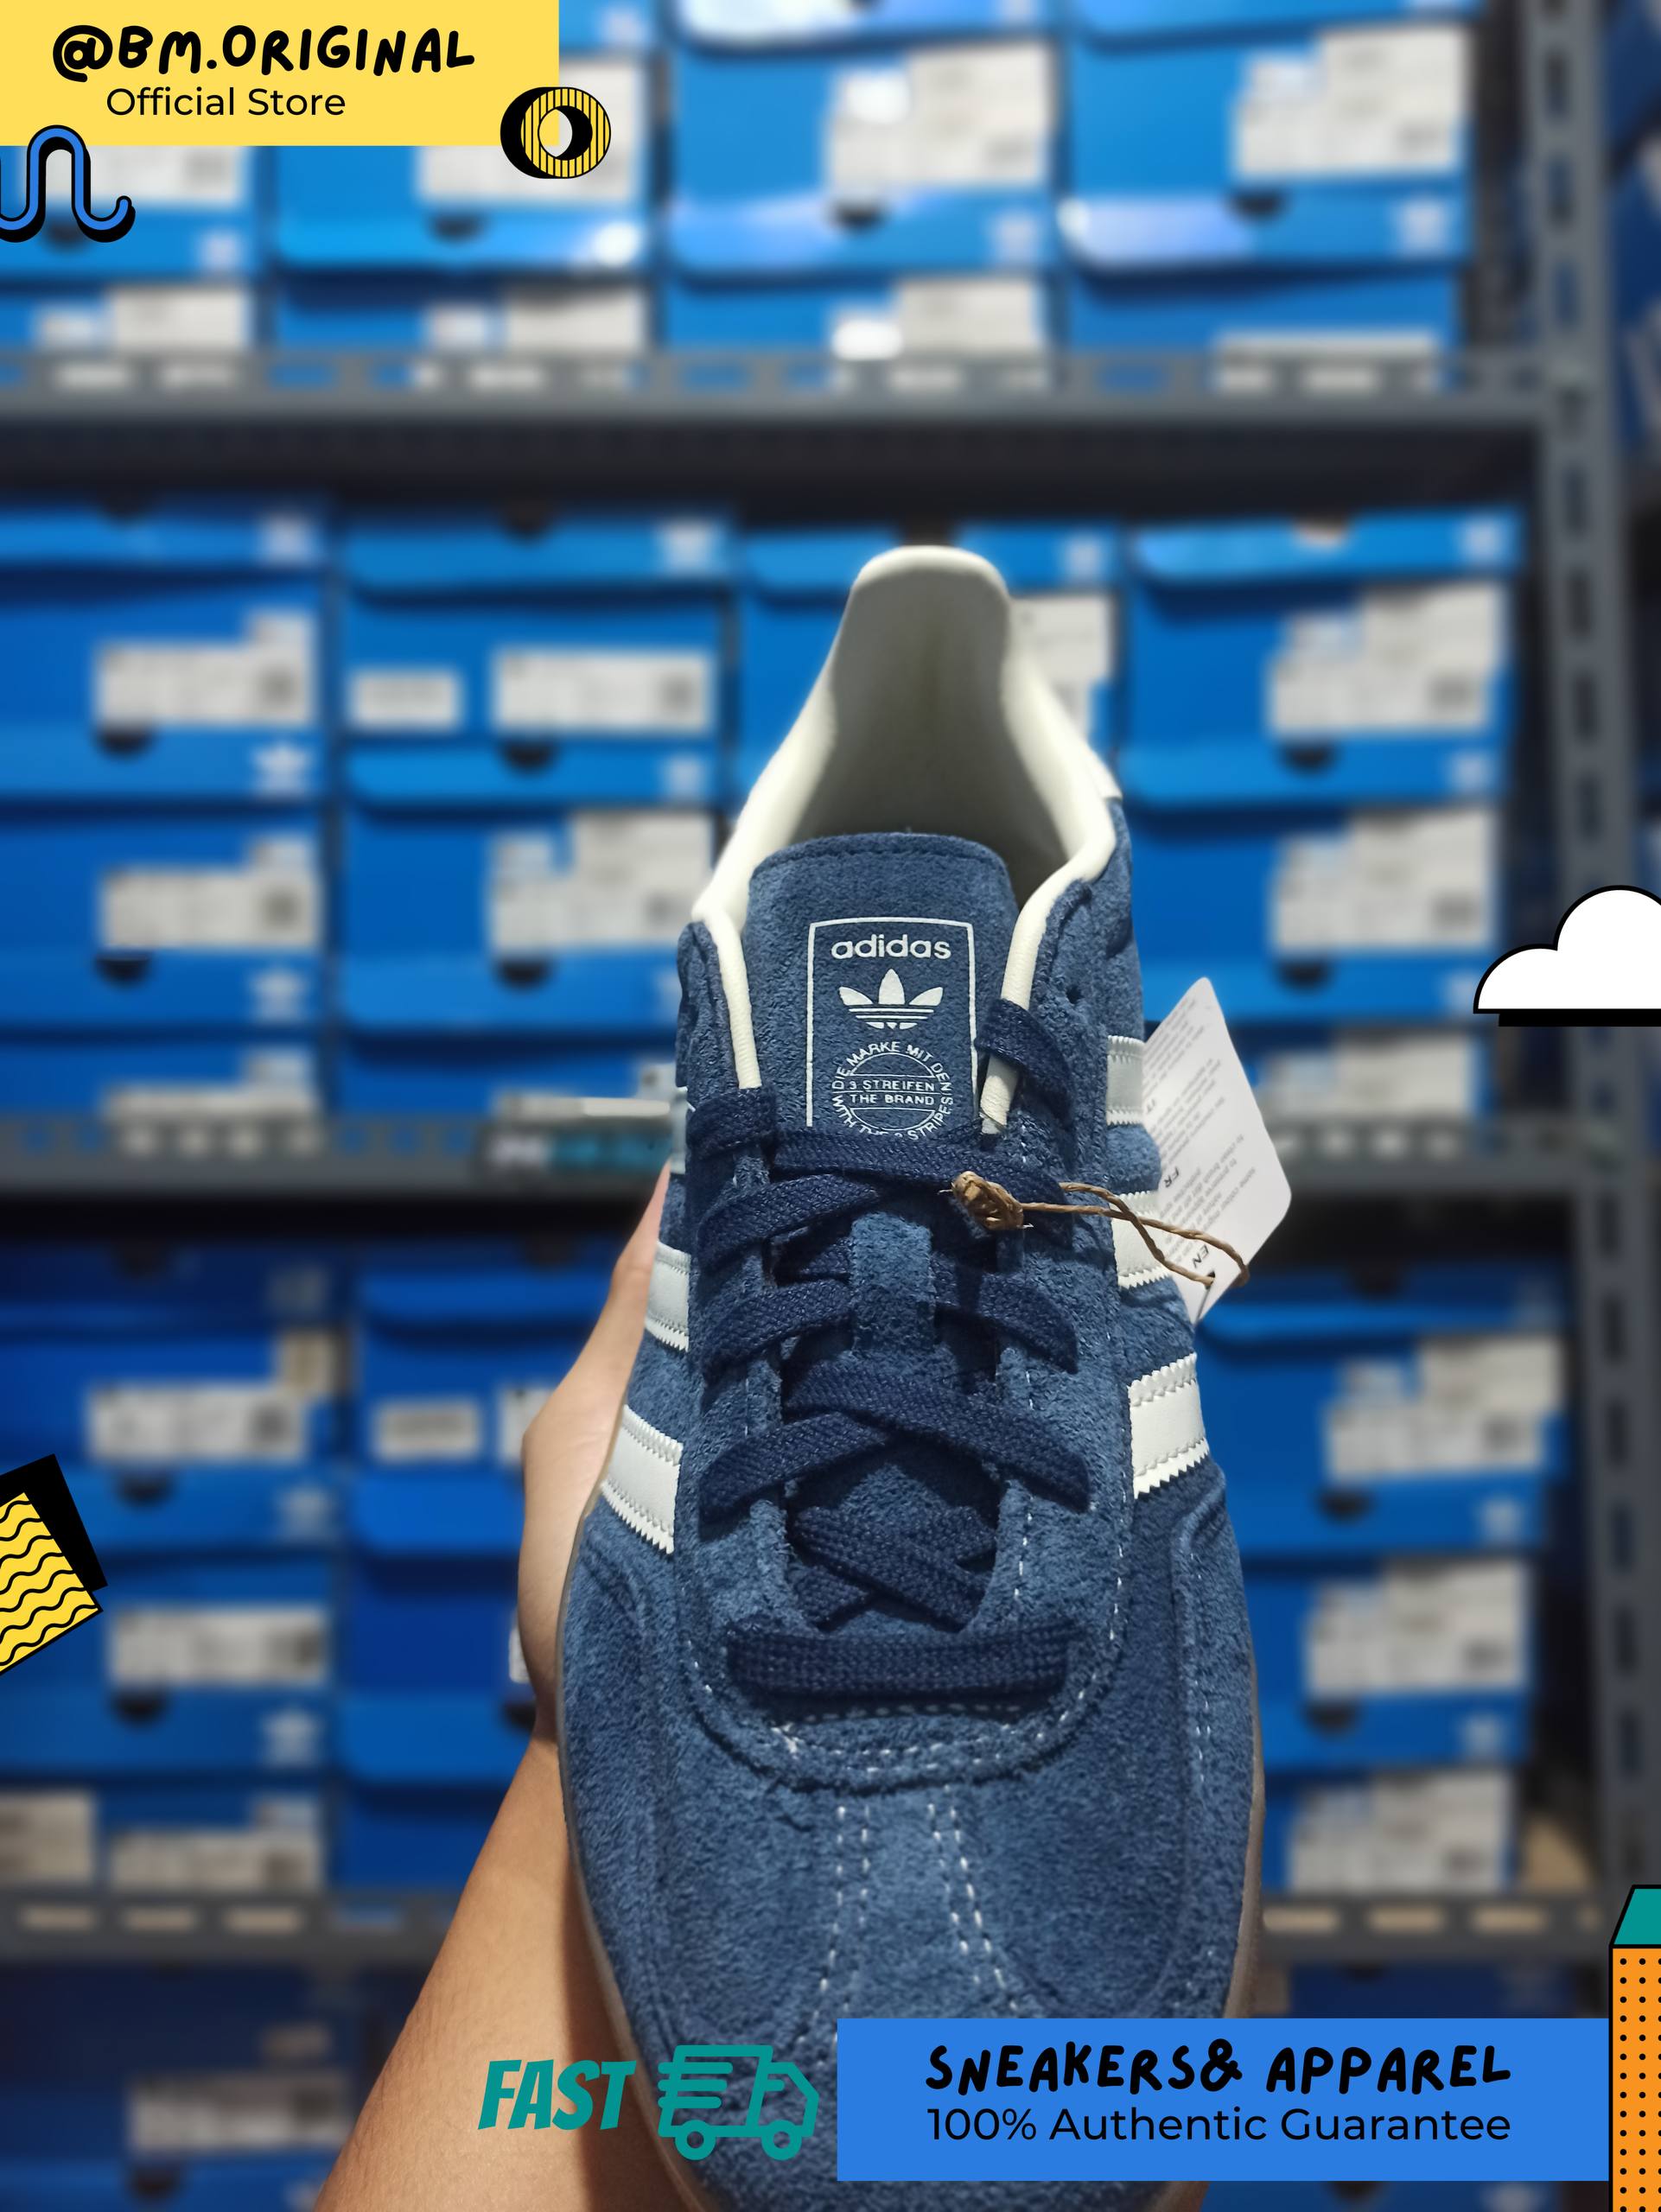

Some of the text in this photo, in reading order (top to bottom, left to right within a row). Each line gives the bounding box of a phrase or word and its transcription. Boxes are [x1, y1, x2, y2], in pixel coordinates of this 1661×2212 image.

[831, 934, 951, 960] adidas
[832, 1041, 952, 1091] DIE MARKE MIT DEN
[850, 1080, 935, 1091] 3 STREIFEN
[850, 1094, 935, 1105] THE BRAND
[832, 1096, 953, 1141] WITH STRIPES
[1163, 1166, 1180, 1188] FR
[1191, 1244, 1209, 1268] EN
